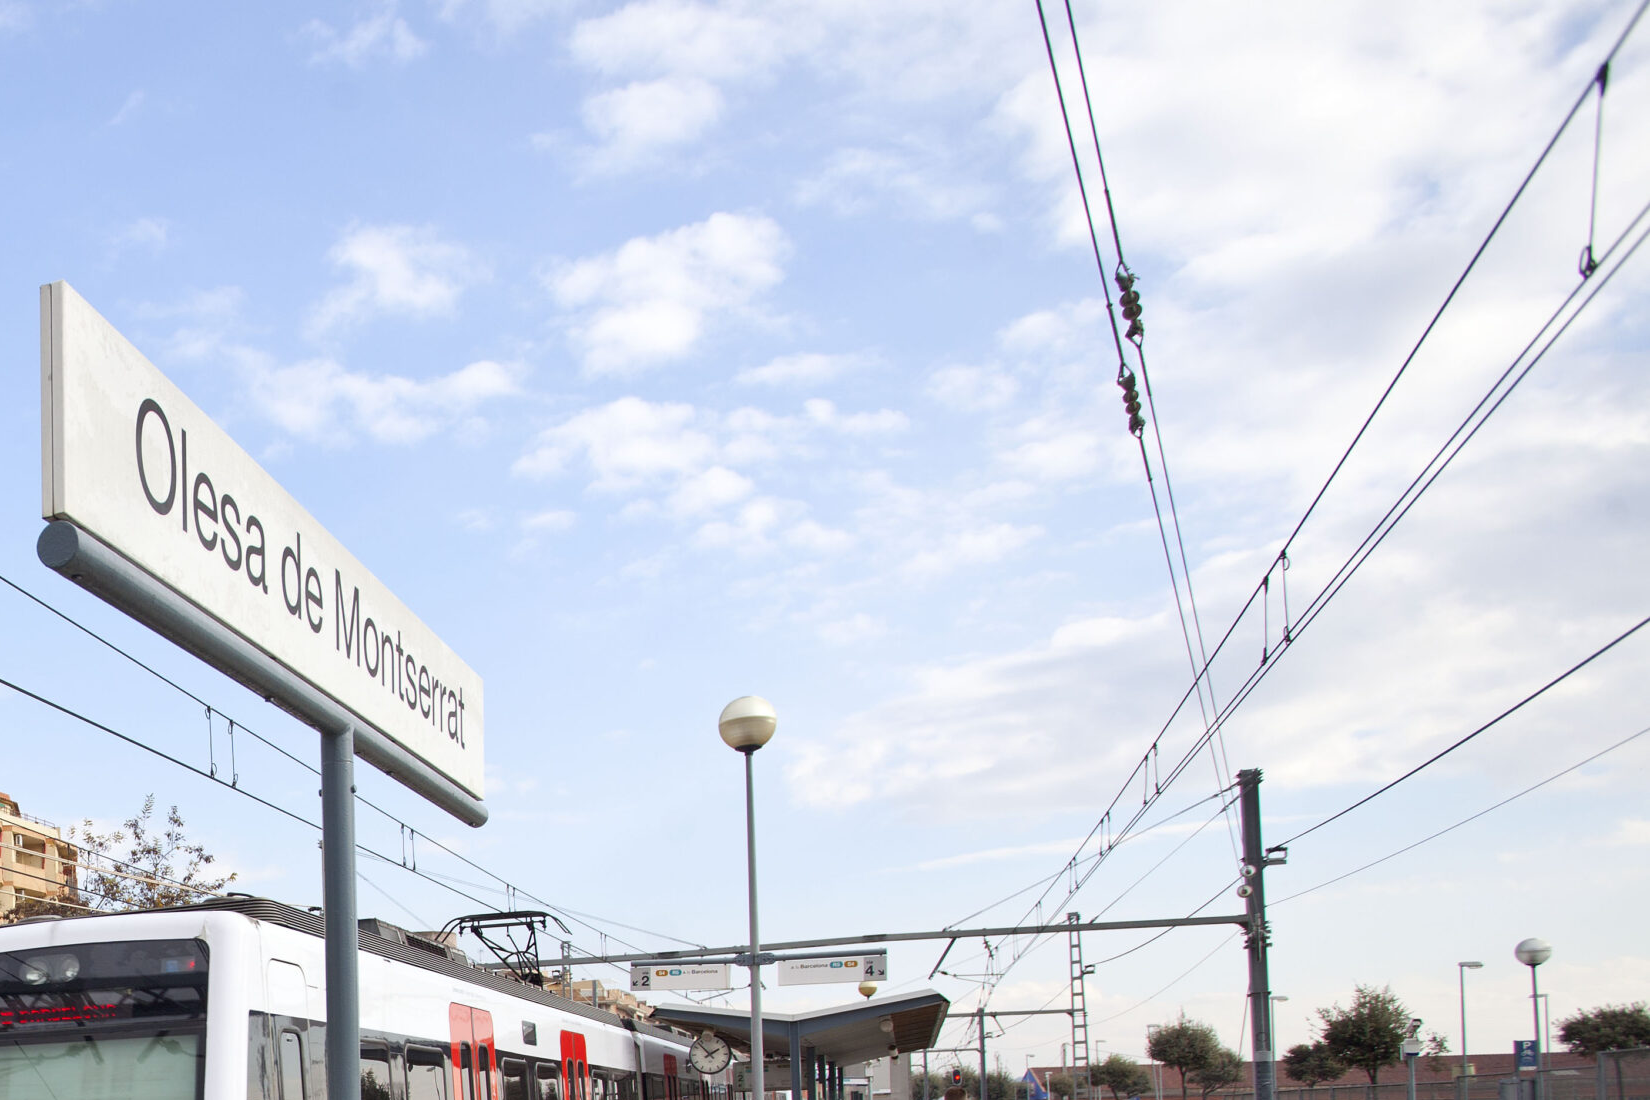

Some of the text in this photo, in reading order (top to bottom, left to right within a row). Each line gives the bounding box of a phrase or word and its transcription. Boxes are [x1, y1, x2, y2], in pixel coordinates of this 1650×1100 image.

[135, 397, 466, 750] Olesa de Montserrat
[865, 965, 875, 977] 4
[641, 975, 650, 987] 2
[1522, 1041, 1532, 1050] P
